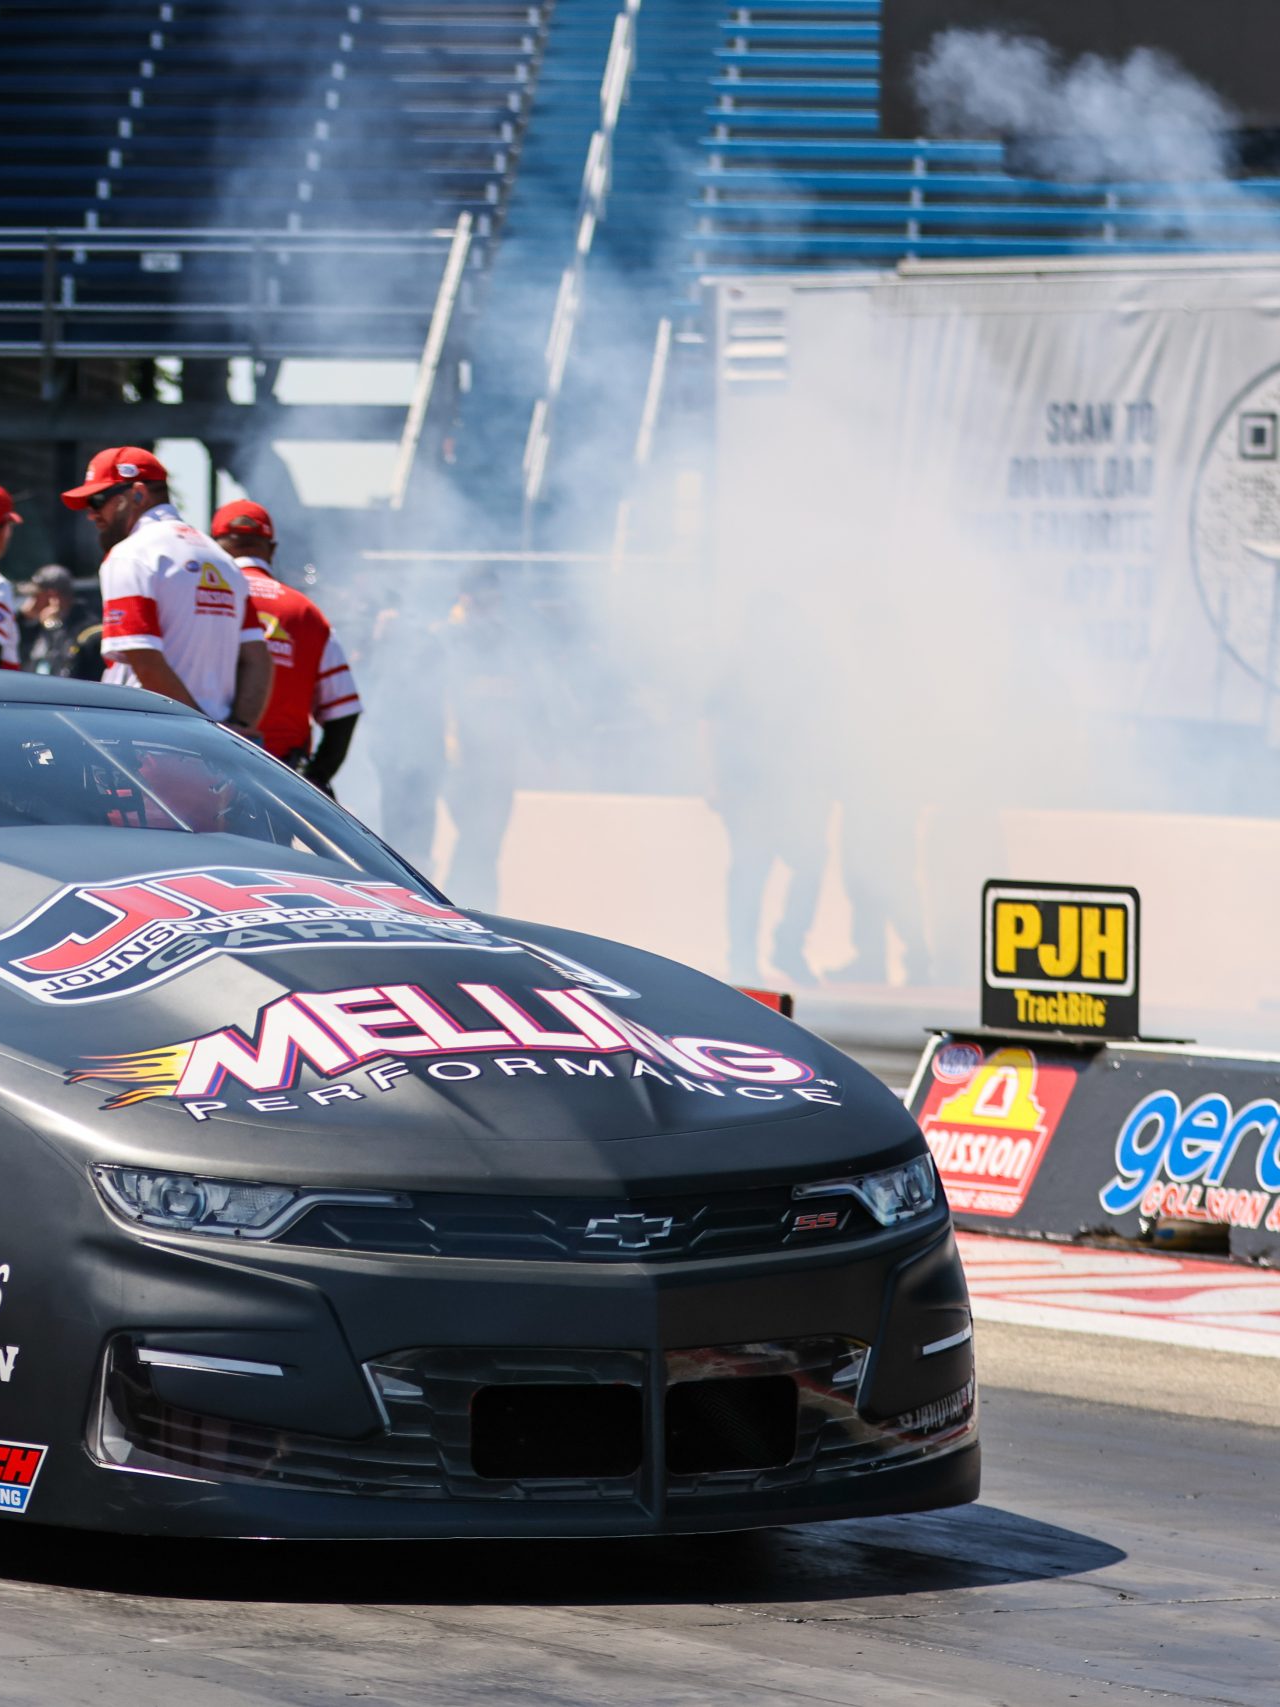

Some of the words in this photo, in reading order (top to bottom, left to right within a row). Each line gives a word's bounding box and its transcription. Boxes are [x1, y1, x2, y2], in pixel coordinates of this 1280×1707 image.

[1046, 401, 1114, 445] SCAN
[42, 913, 262, 992] JOHNSON'S
[146, 921, 512, 971] GARAG
[995, 902, 1125, 980] PJH
[187, 1057, 842, 1122] PERFORMANCE
[792, 1212, 838, 1231] SS
